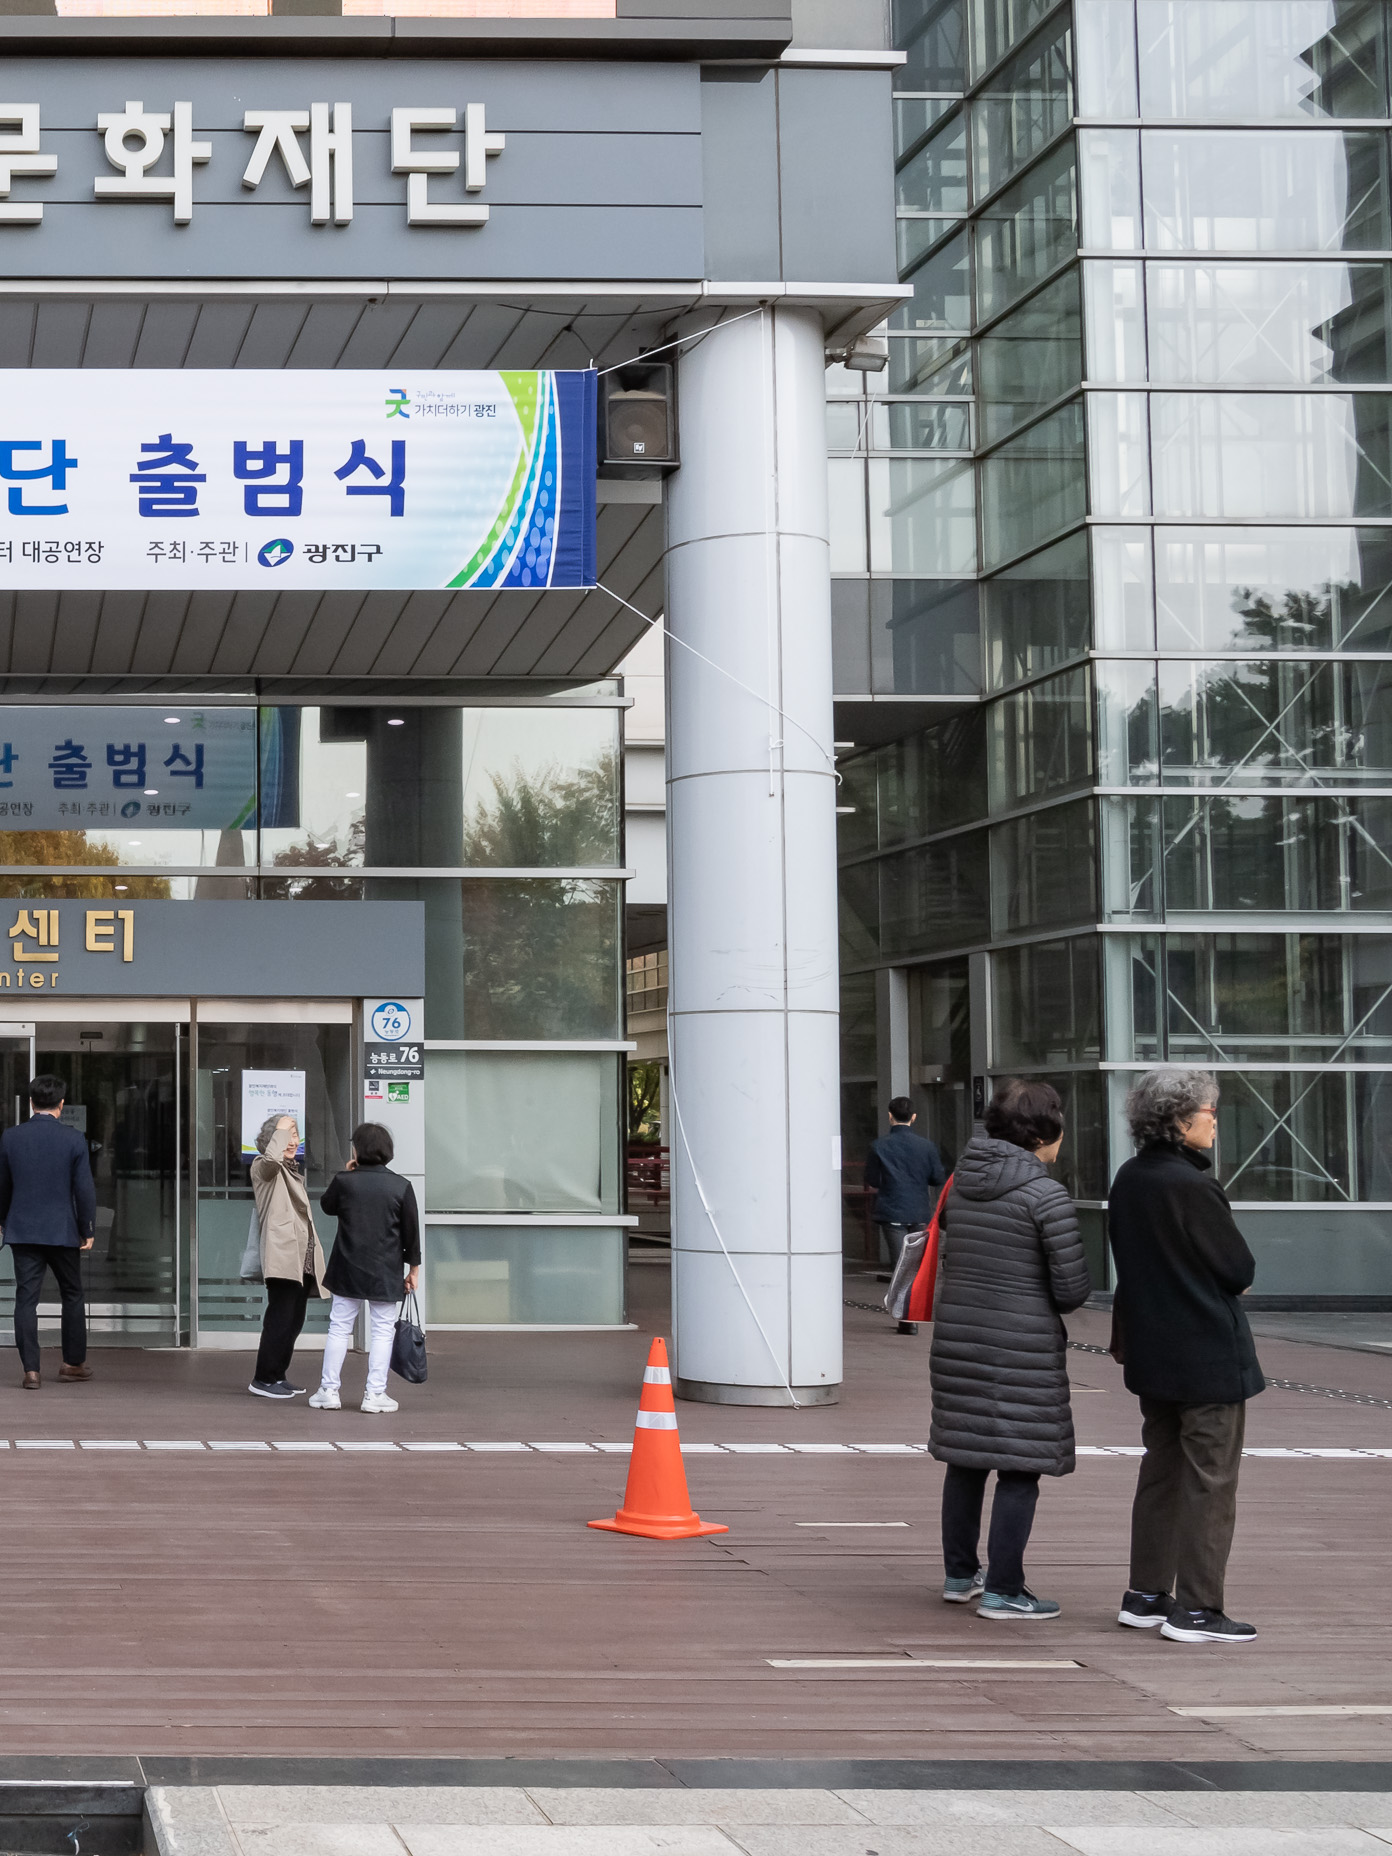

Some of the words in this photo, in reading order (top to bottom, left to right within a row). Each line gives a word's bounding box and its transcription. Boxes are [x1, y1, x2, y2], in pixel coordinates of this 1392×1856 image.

[415, 404, 471, 417] 가치더하기
[473, 404, 496, 418] 광진
[130, 434, 406, 517] 출범식
[22, 541, 104, 564] 대공연장
[303, 544, 383, 564] 광진구
[48, 740, 205, 788] 출범식
[382, 1017, 401, 1029] 76
[369, 1052, 398, 1064] 능동로
[399, 1046, 420, 1063] 76
[377, 1068, 421, 1076] Neungdong-ro
